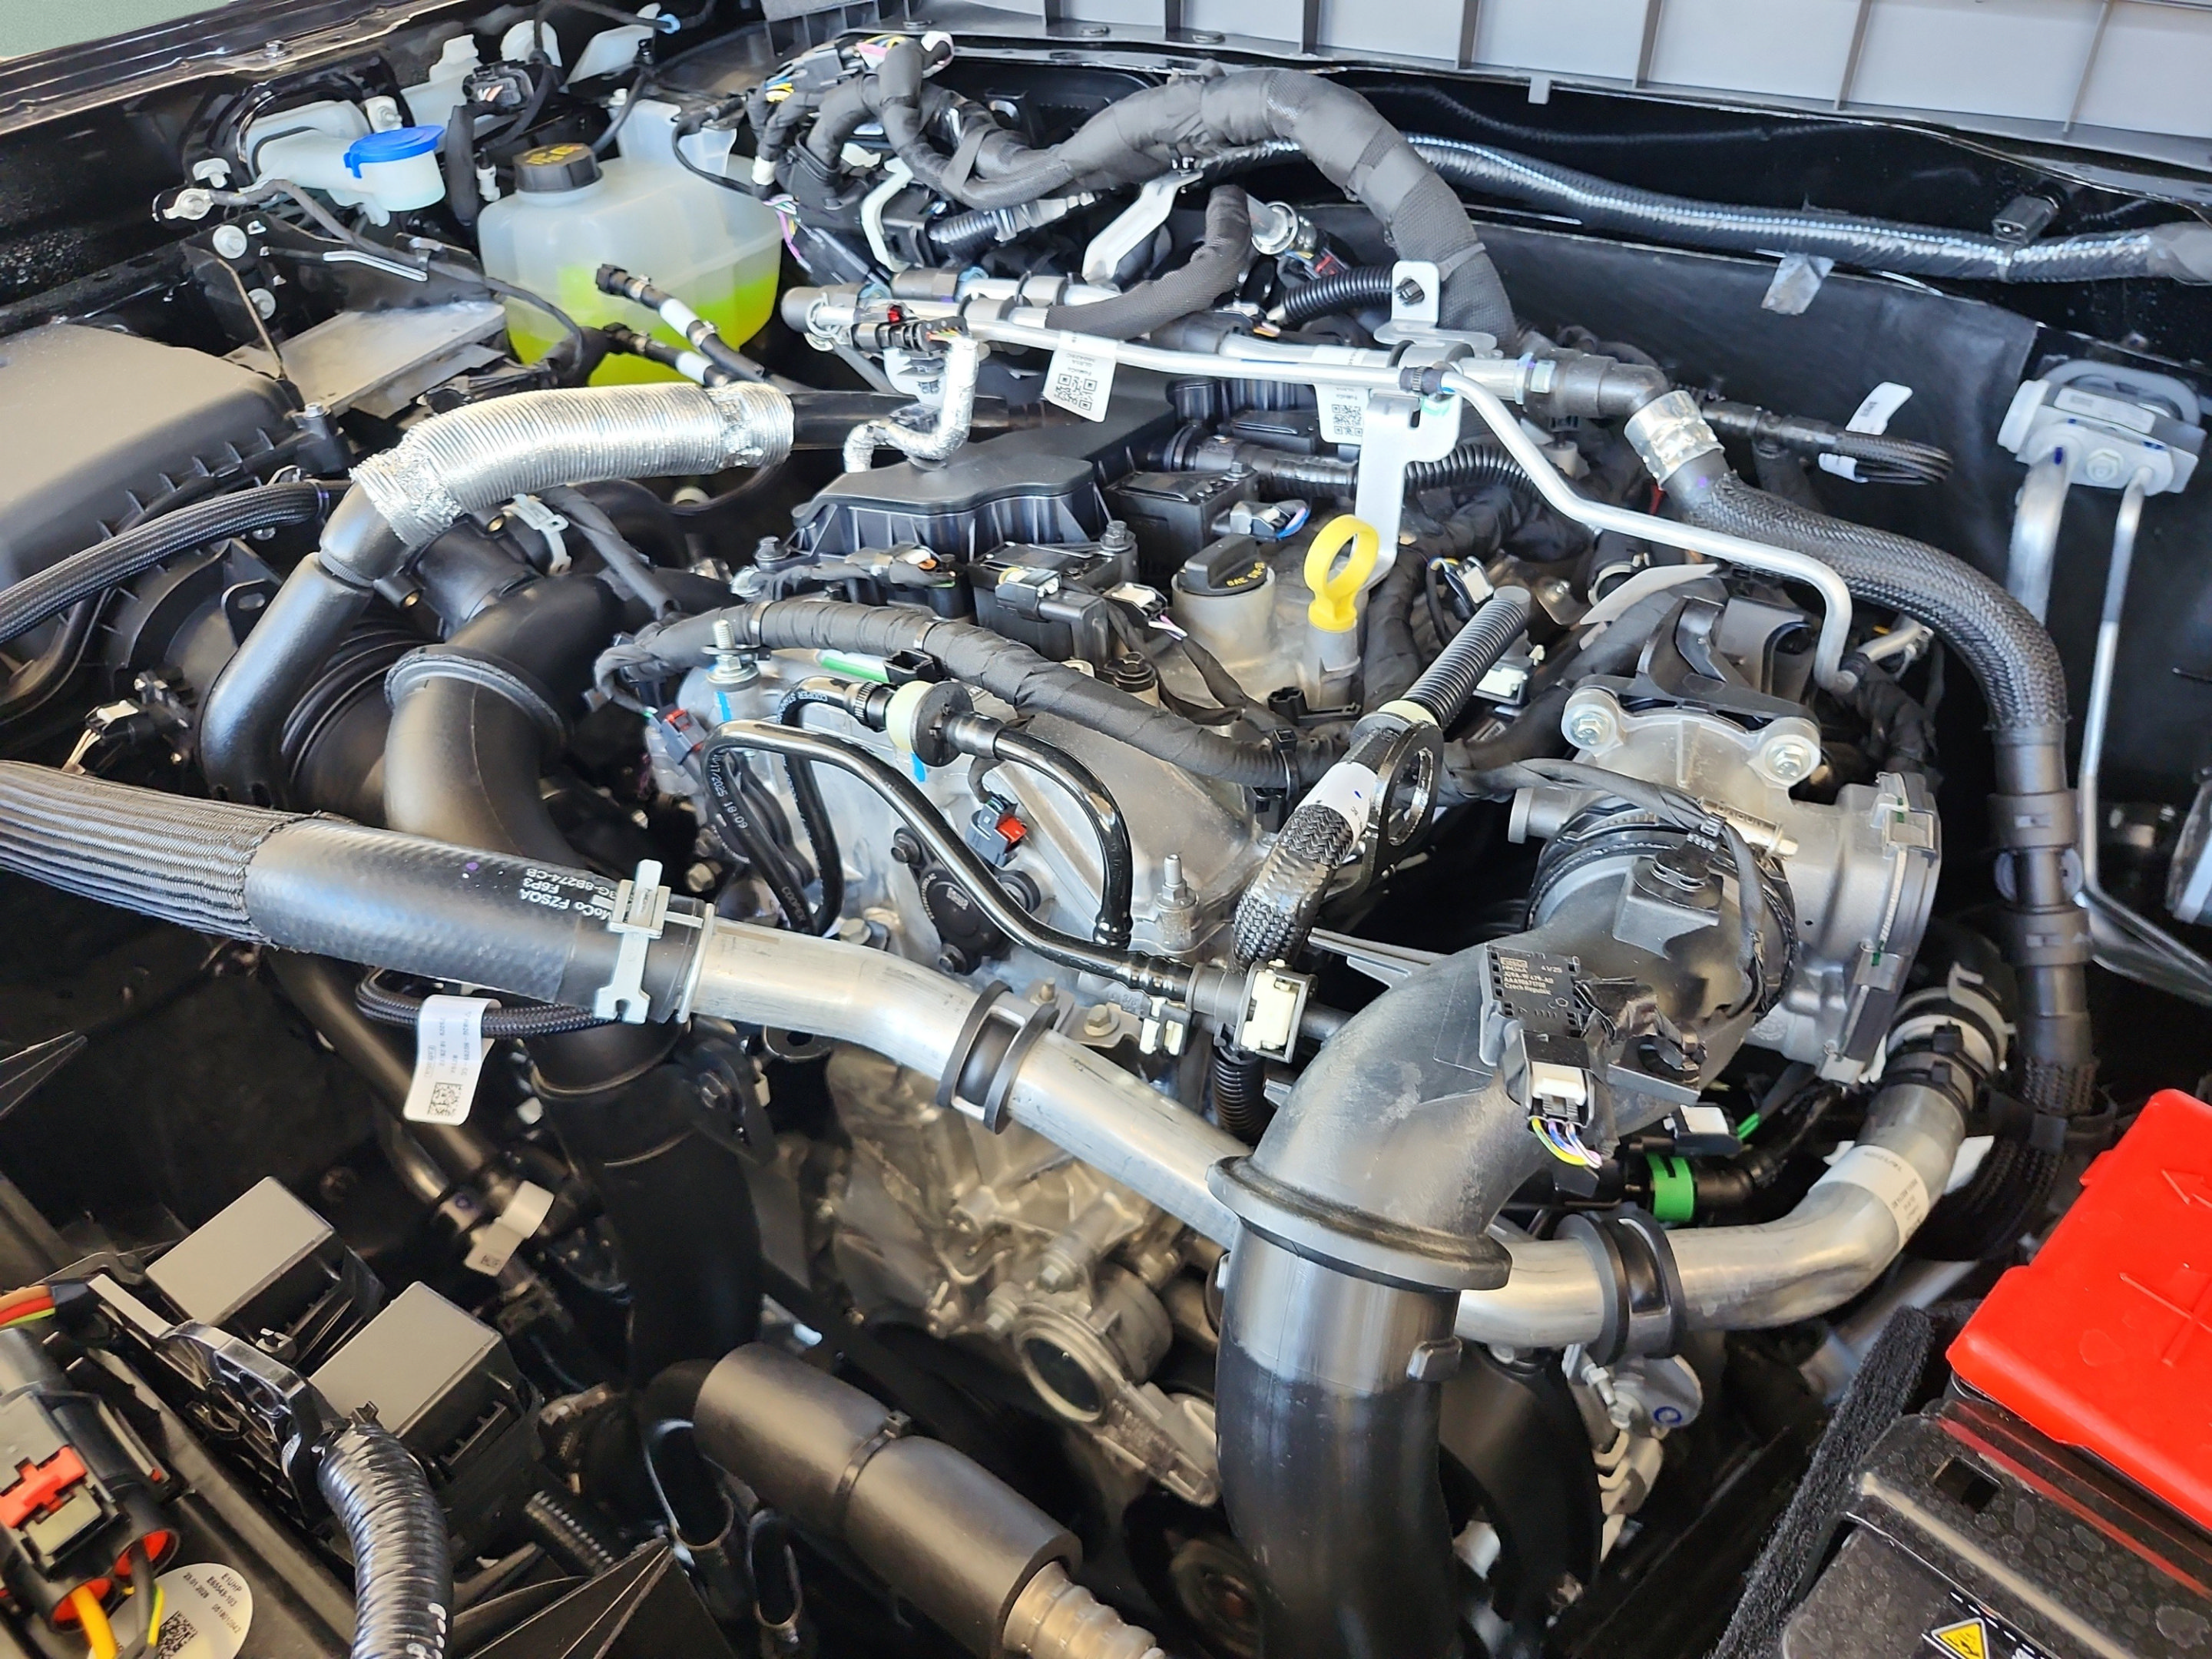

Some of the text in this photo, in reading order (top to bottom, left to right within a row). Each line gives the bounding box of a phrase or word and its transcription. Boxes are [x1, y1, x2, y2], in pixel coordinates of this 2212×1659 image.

[797, 691, 829, 702] COOPER
[724, 800, 749, 830] 18:09
[522, 877, 560, 894] F6P3
[526, 868, 618, 899] 3G-8B274-CB
[574, 901, 614, 920] MoCo
[781, 886, 806, 922] COOPER
